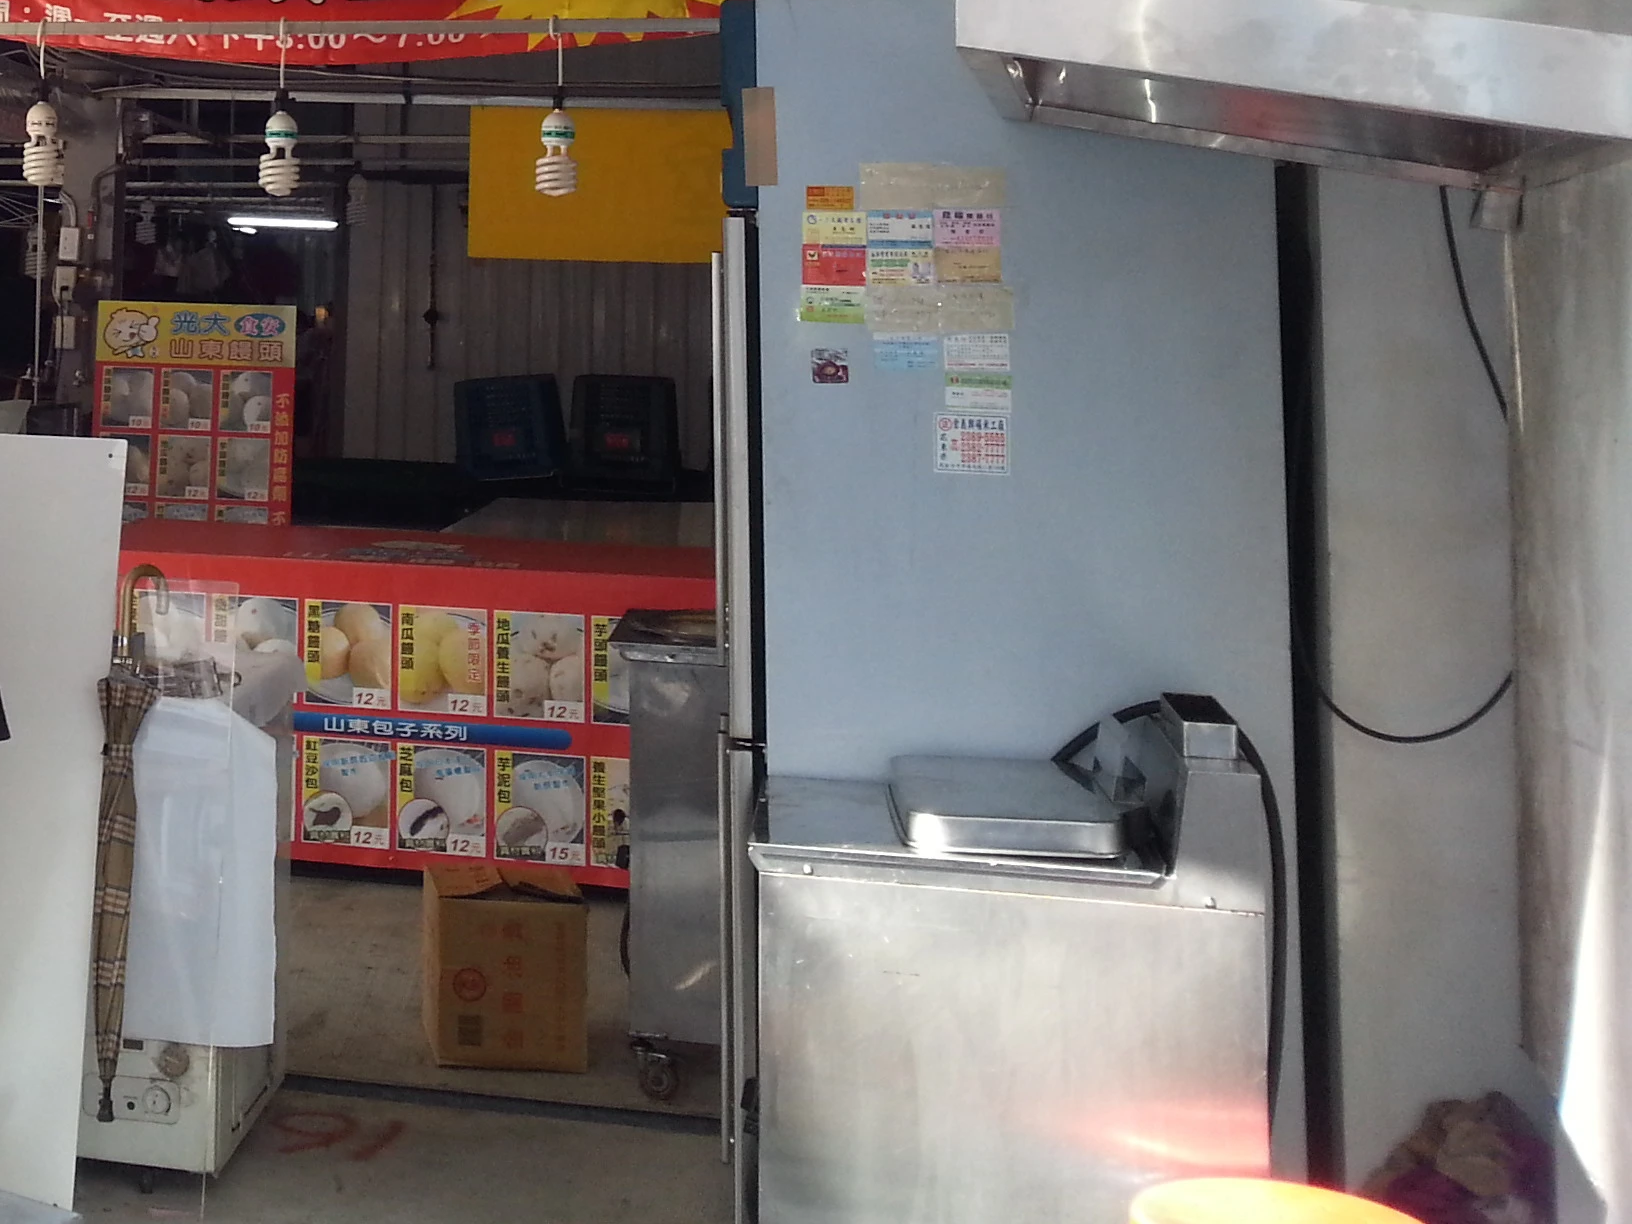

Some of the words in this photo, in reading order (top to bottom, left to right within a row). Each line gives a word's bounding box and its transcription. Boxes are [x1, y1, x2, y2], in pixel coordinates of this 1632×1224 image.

[172, 311, 230, 336] 光大
[170, 338, 284, 363] 山東饅頭
[401, 613, 414, 670] 南瓜饅頭
[593, 623, 608, 683] 芋頭饅頭
[324, 717, 468, 741] 山東包子系列
[305, 740, 318, 789] 紅豆沙包
[399, 747, 413, 793] 芝麻包
[497, 757, 511, 804] 芋泥包
